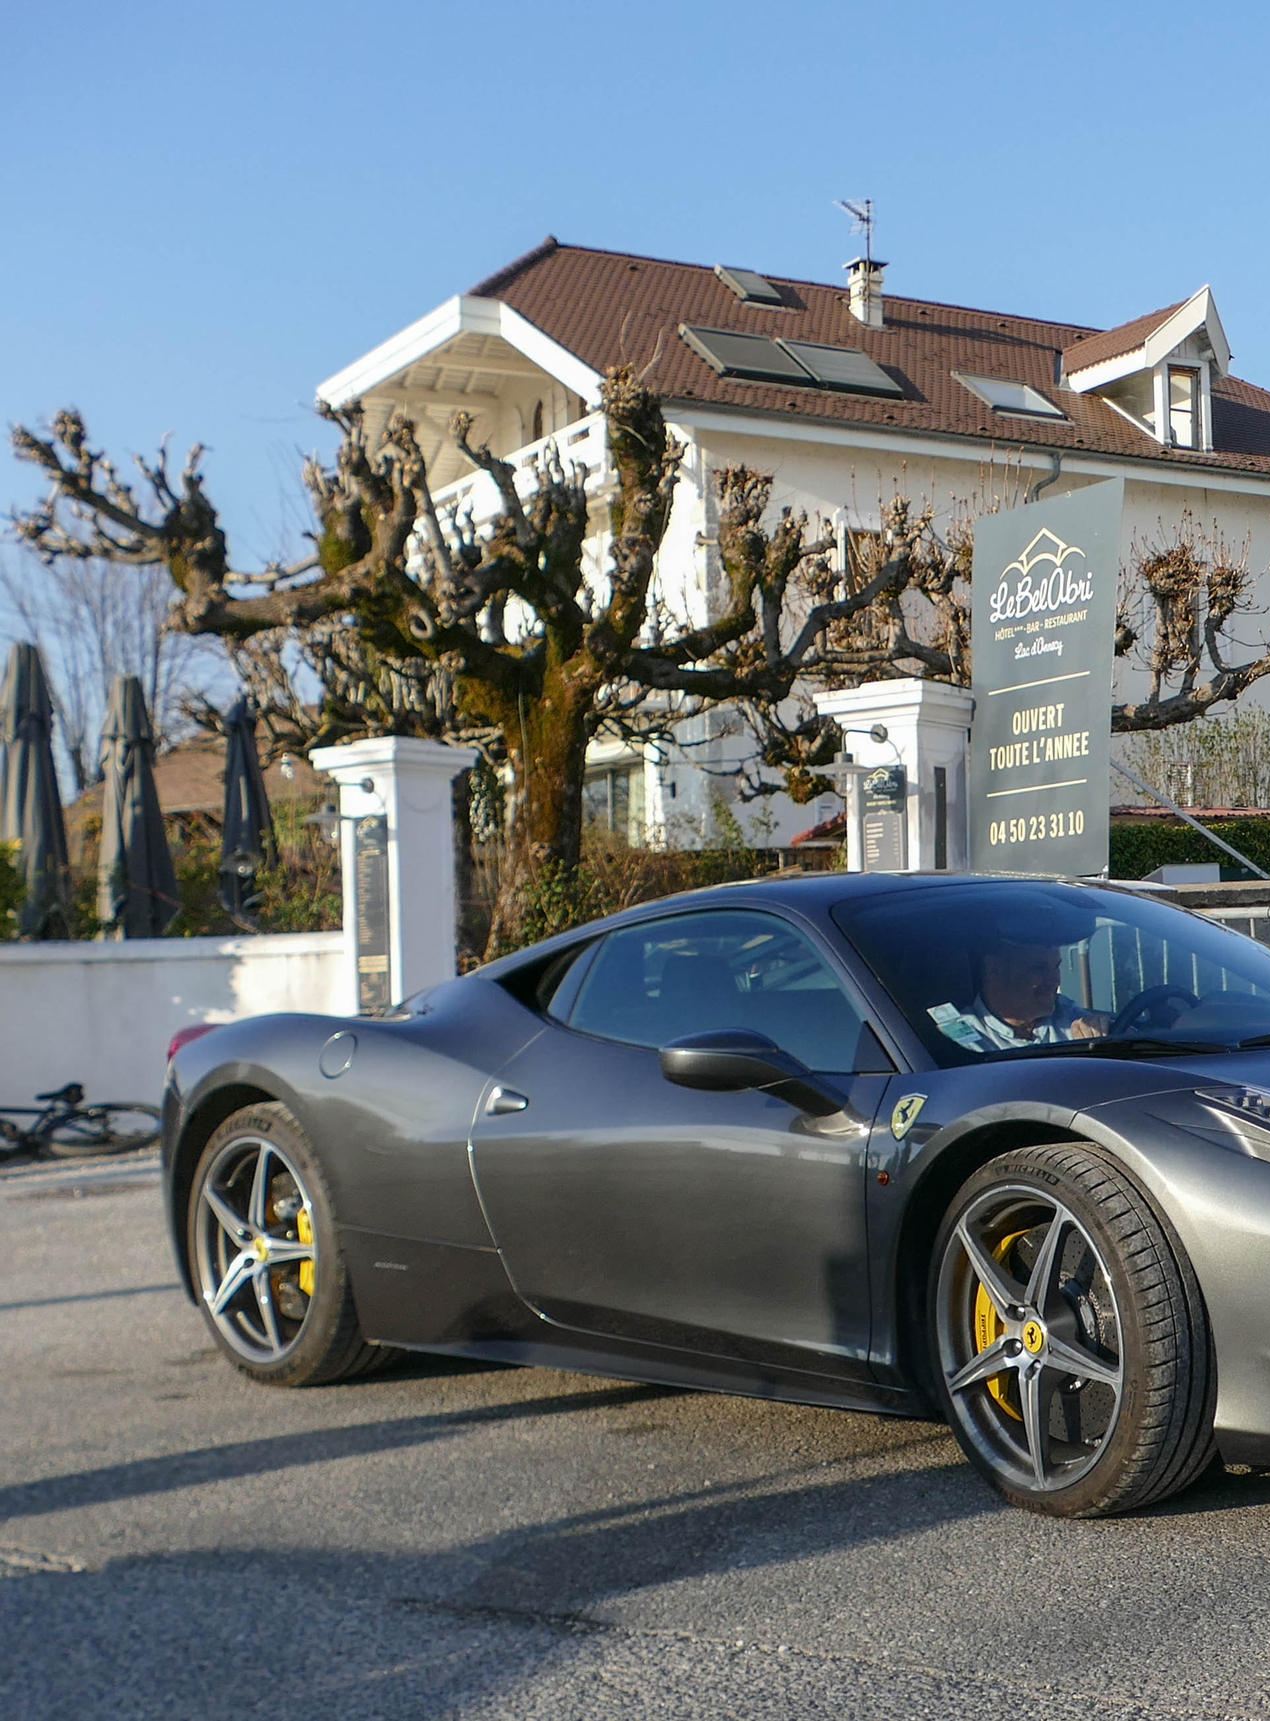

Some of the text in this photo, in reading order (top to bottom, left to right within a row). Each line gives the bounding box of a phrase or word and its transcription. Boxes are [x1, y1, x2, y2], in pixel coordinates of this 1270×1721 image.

[1044, 609, 1088, 629] RESTAURANT
[1012, 703, 1065, 736] OUVERT
[990, 731, 1089, 771] TOUTE L'ANNEE
[990, 810, 1084, 846] 04 50 23 31 10
